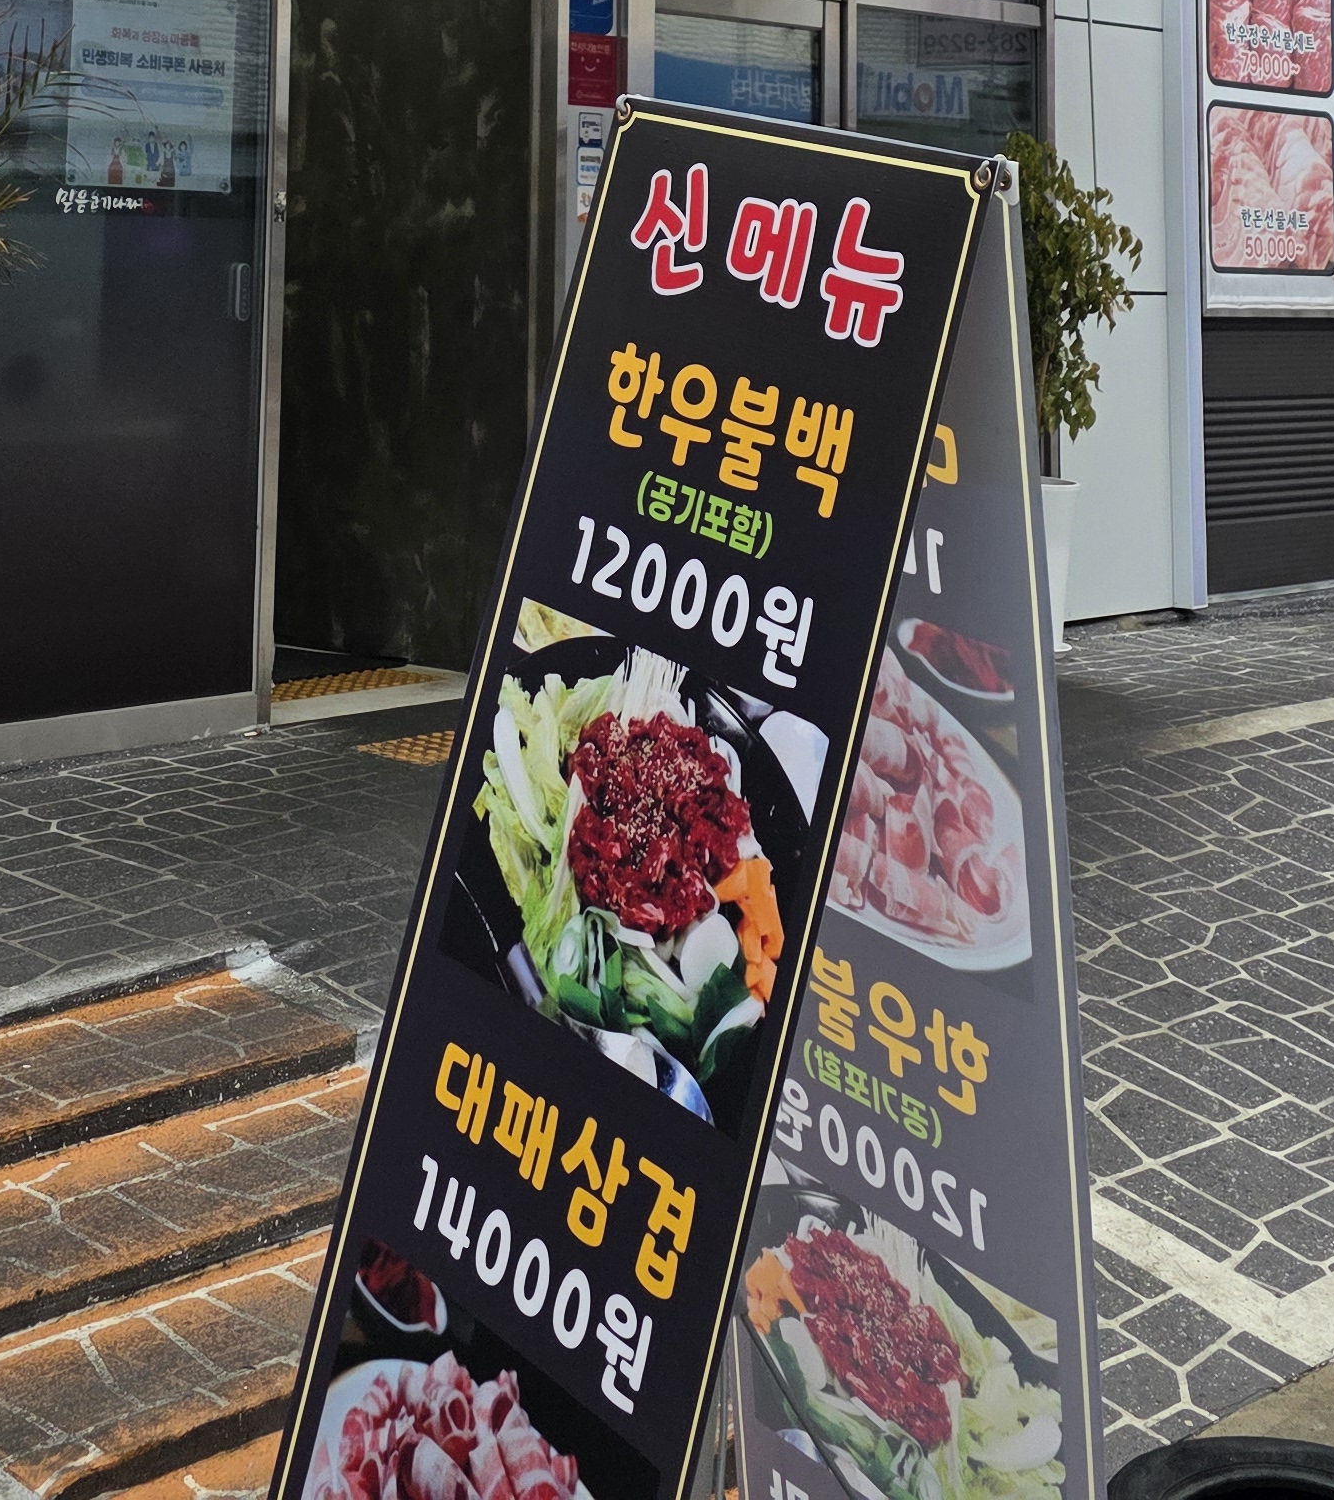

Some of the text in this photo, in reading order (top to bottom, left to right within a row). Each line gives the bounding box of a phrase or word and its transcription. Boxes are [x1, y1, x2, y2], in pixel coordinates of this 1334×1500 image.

[82, 48, 133, 68] 민생회복
[136, 53, 185, 73] 소비쿠폰
[1225, 21, 1316, 53] 한우정육선물세트
[1240, 50, 1301, 79] 79,000~
[1240, 208, 1309, 230] 한돈선물세트
[1245, 237, 1305, 261] 50,000~
[630, 162, 905, 348] 신메뉴
[607, 342, 854, 519] 한우불백
[636, 470, 774, 560] (공기포함)
[571, 515, 813, 688] 12000원
[413, 1154, 653, 1414] 14000원
